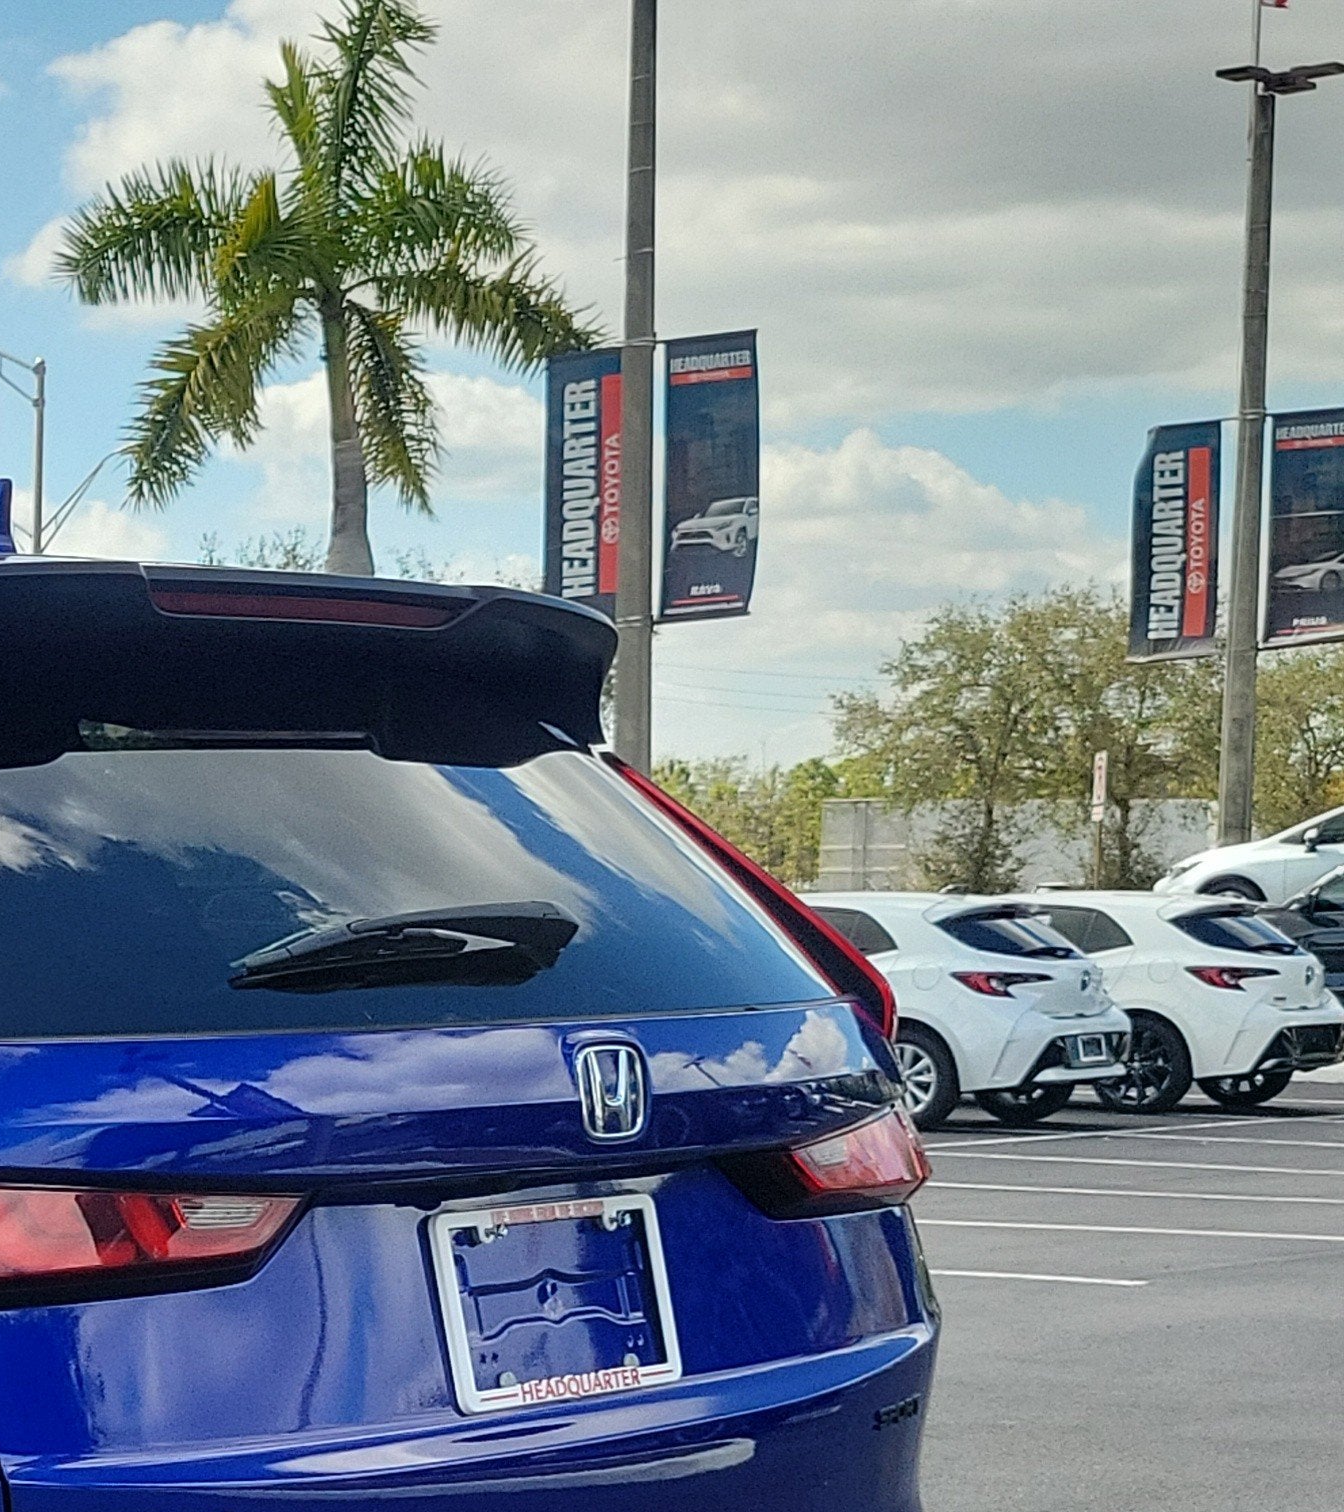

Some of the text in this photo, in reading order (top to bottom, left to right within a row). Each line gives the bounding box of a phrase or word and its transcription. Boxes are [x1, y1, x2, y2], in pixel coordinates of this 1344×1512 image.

[669, 350, 751, 373] HEADQUARTER
[562, 379, 600, 600] HEADQUARTER
[603, 433, 622, 517] TOYOTA
[1147, 450, 1186, 640] HEADQUARTER
[1189, 497, 1207, 568] TOYOTA
[520, 1369, 641, 1402] HEADQUARTER
